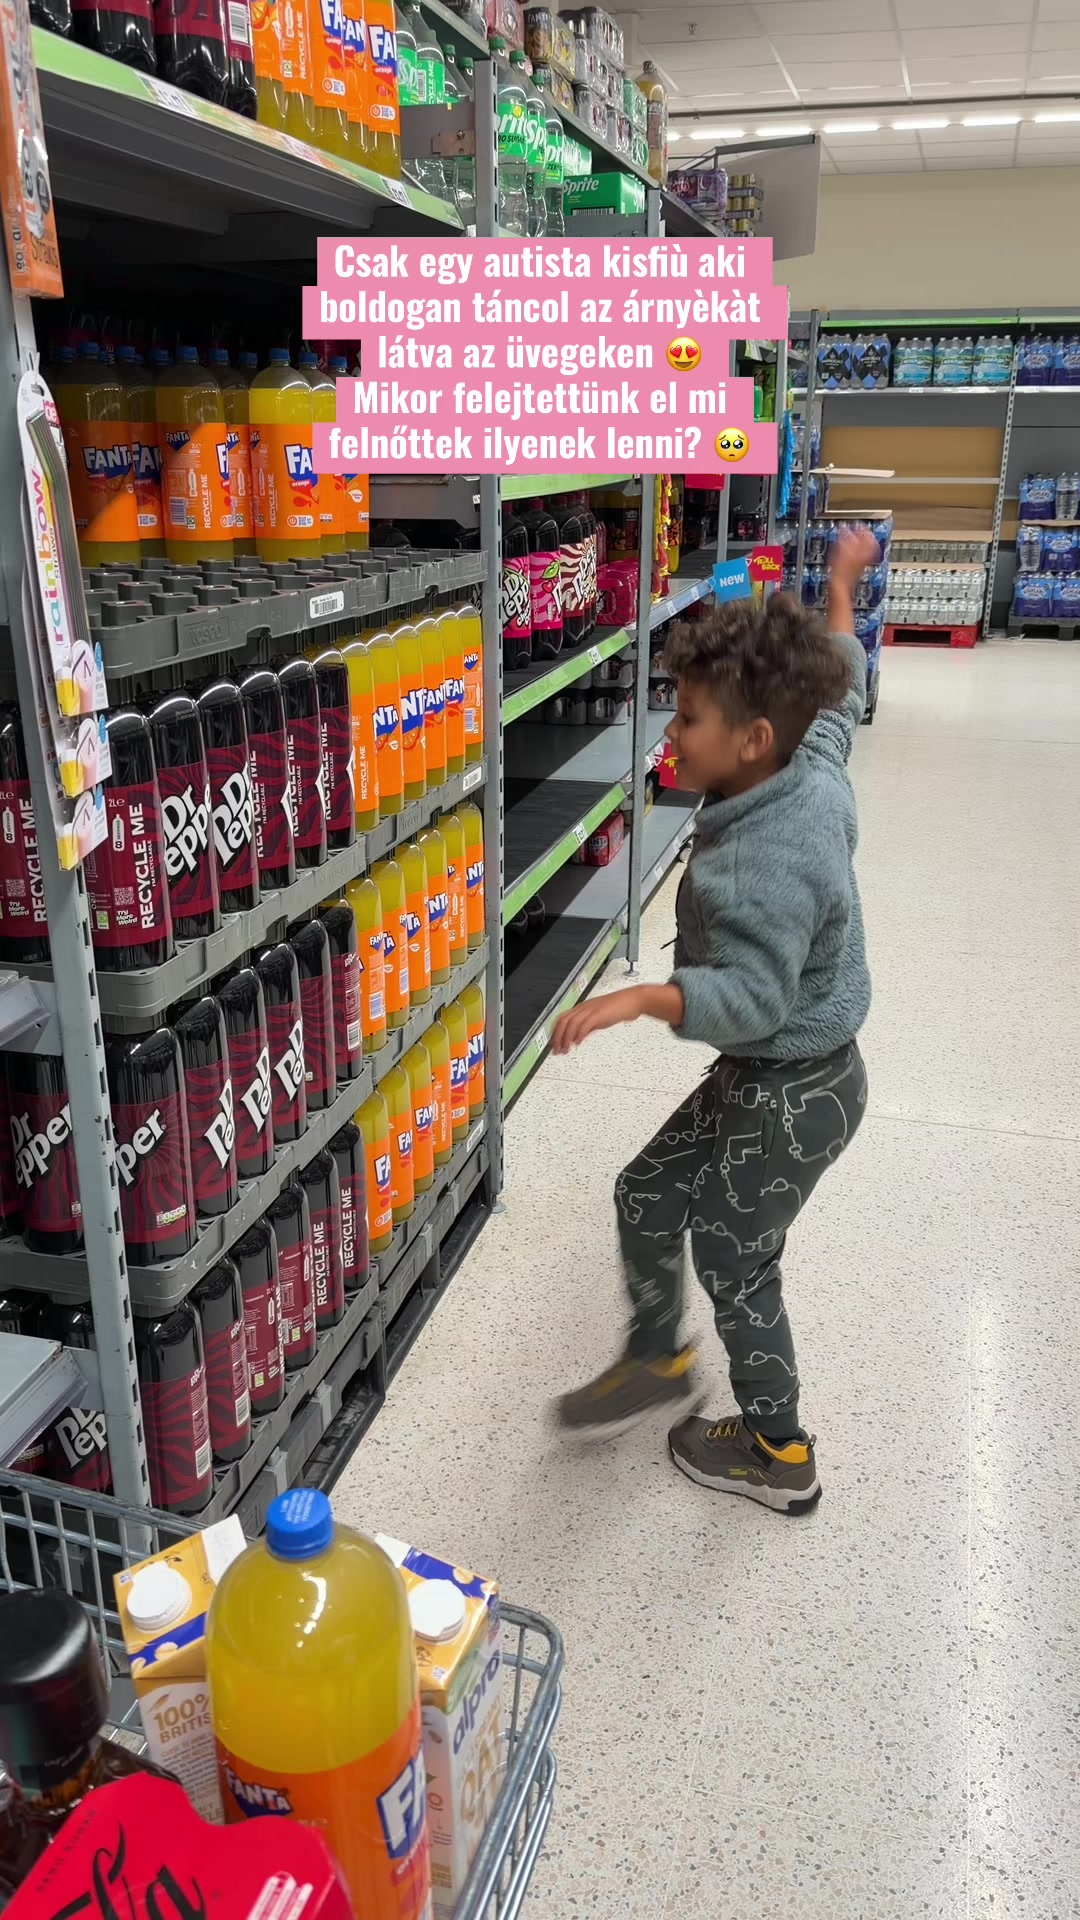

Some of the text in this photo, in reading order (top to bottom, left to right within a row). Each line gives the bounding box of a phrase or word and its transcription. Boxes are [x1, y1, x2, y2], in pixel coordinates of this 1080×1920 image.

[84, 446, 132, 469] FANTA
[166, 431, 190, 442] FANTA
[201, 474, 212, 528] RECYCLE ME
[268, 473, 277, 528] RECYCLE ME
[31, 467, 63, 643] rainbow
[360, 745, 366, 758] ME
[19, 798, 48, 923] RECYCLE ME
[128, 802, 155, 929] RECYCLE ME
[341, 1187, 354, 1269] RECYCLE ME
[313, 1221, 328, 1306] RECYCLE ME
[453, 1649, 500, 1755] alpro
[226, 1770, 292, 1812] FANTA
